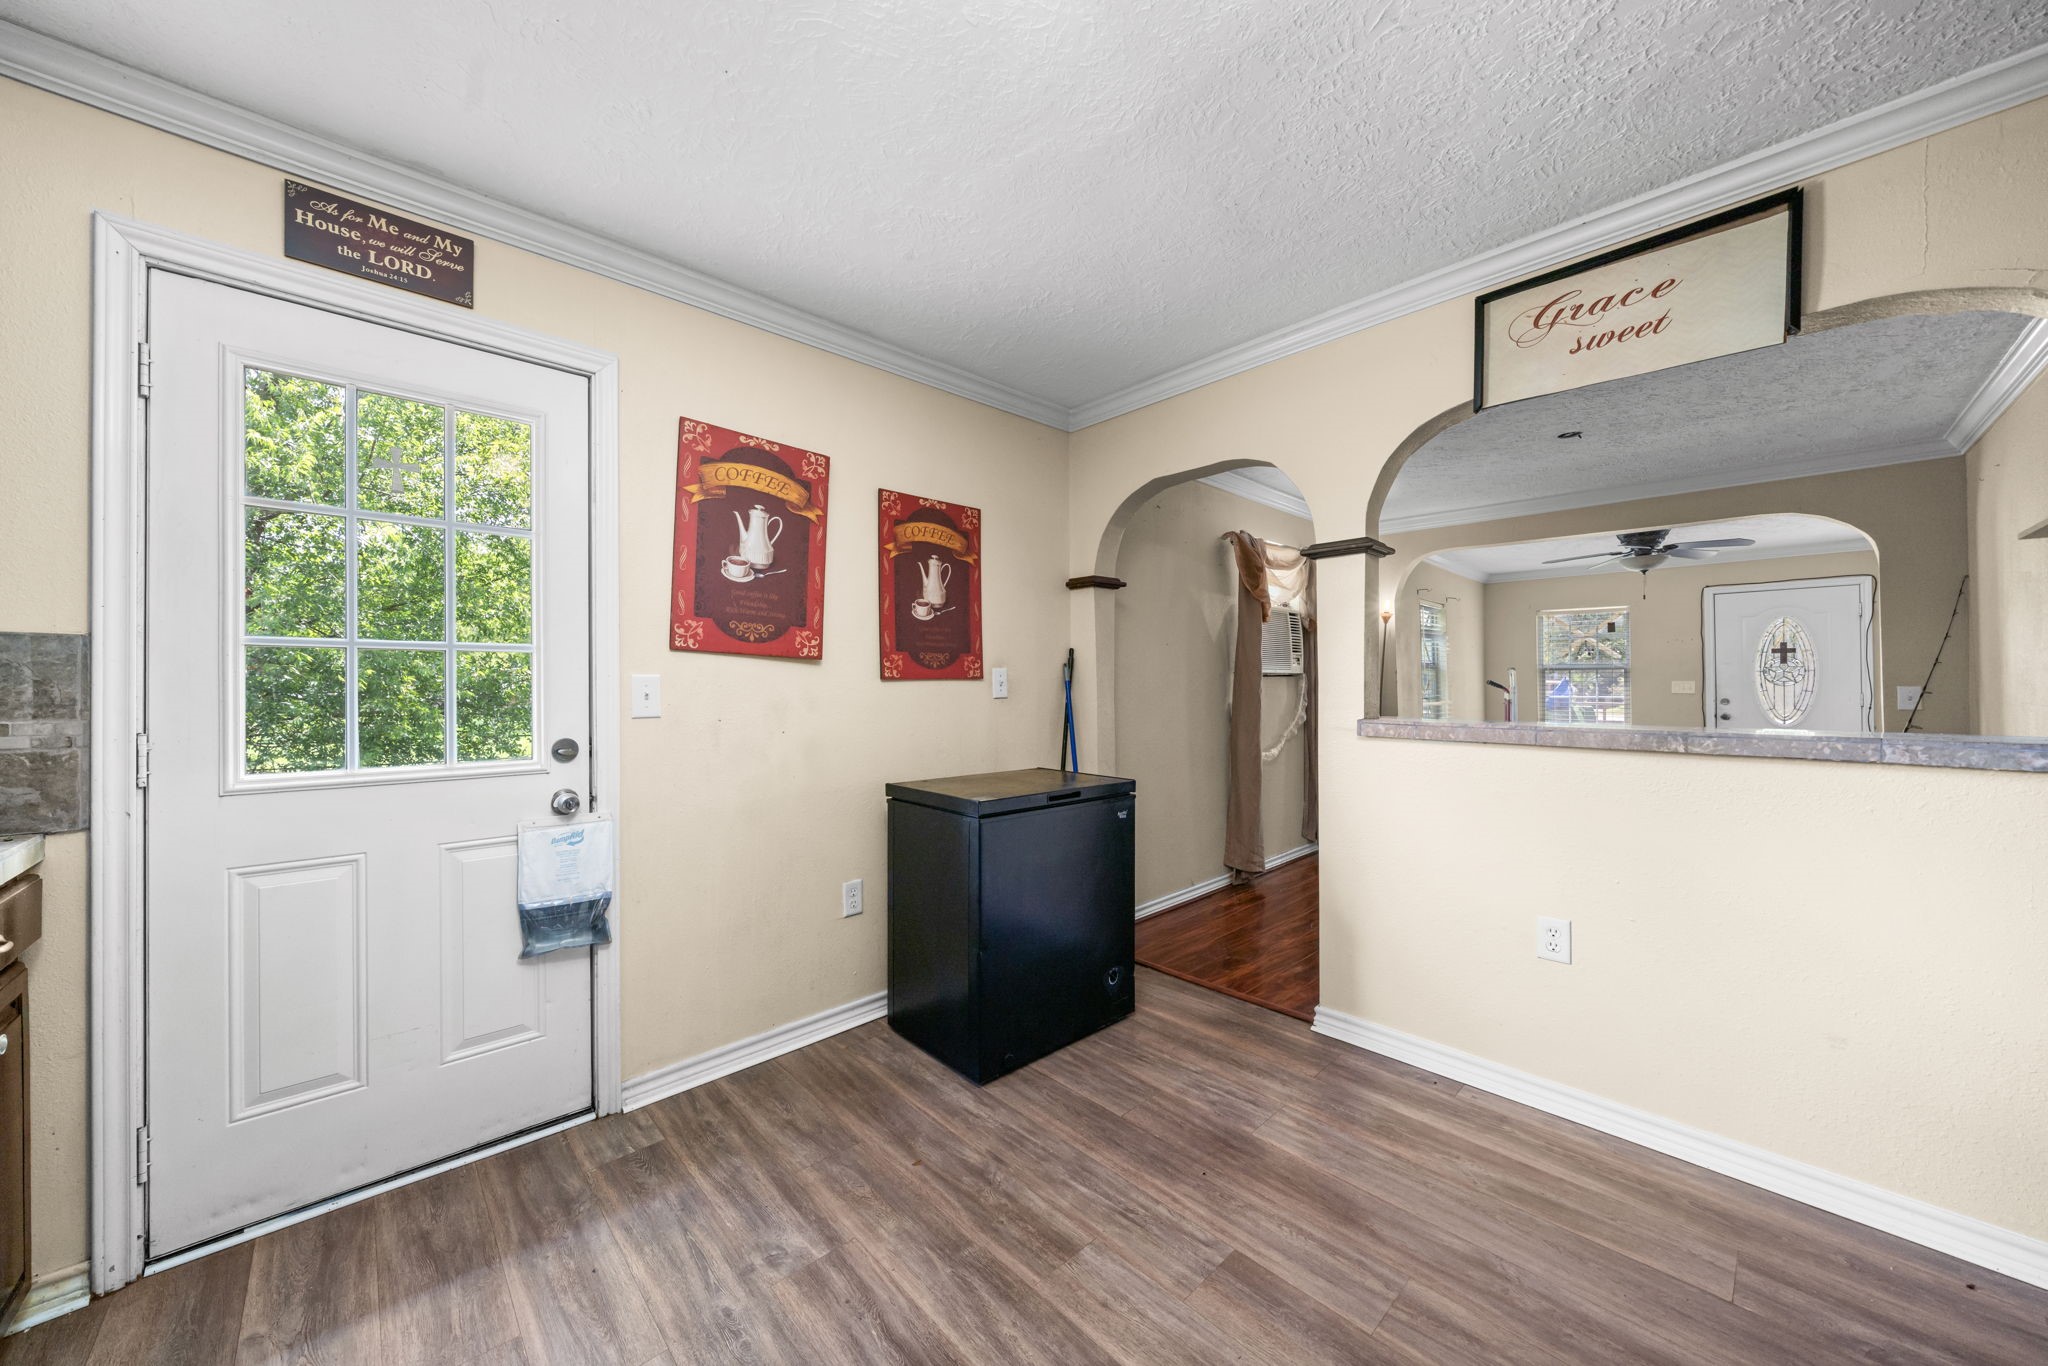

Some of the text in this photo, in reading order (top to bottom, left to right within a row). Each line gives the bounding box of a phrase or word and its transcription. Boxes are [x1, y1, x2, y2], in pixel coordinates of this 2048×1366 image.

[295, 208, 465, 272] House, we will Serve
[310, 200, 462, 257] As for Me and My
[337, 245, 436, 282] the LORD.
[361, 265, 408, 284] Joshua 24:15
[1508, 277, 1684, 349] Grace
[1569, 308, 1673, 355] sweet
[714, 466, 792, 497] COFFEE
[903, 525, 955, 546] COFFEE
